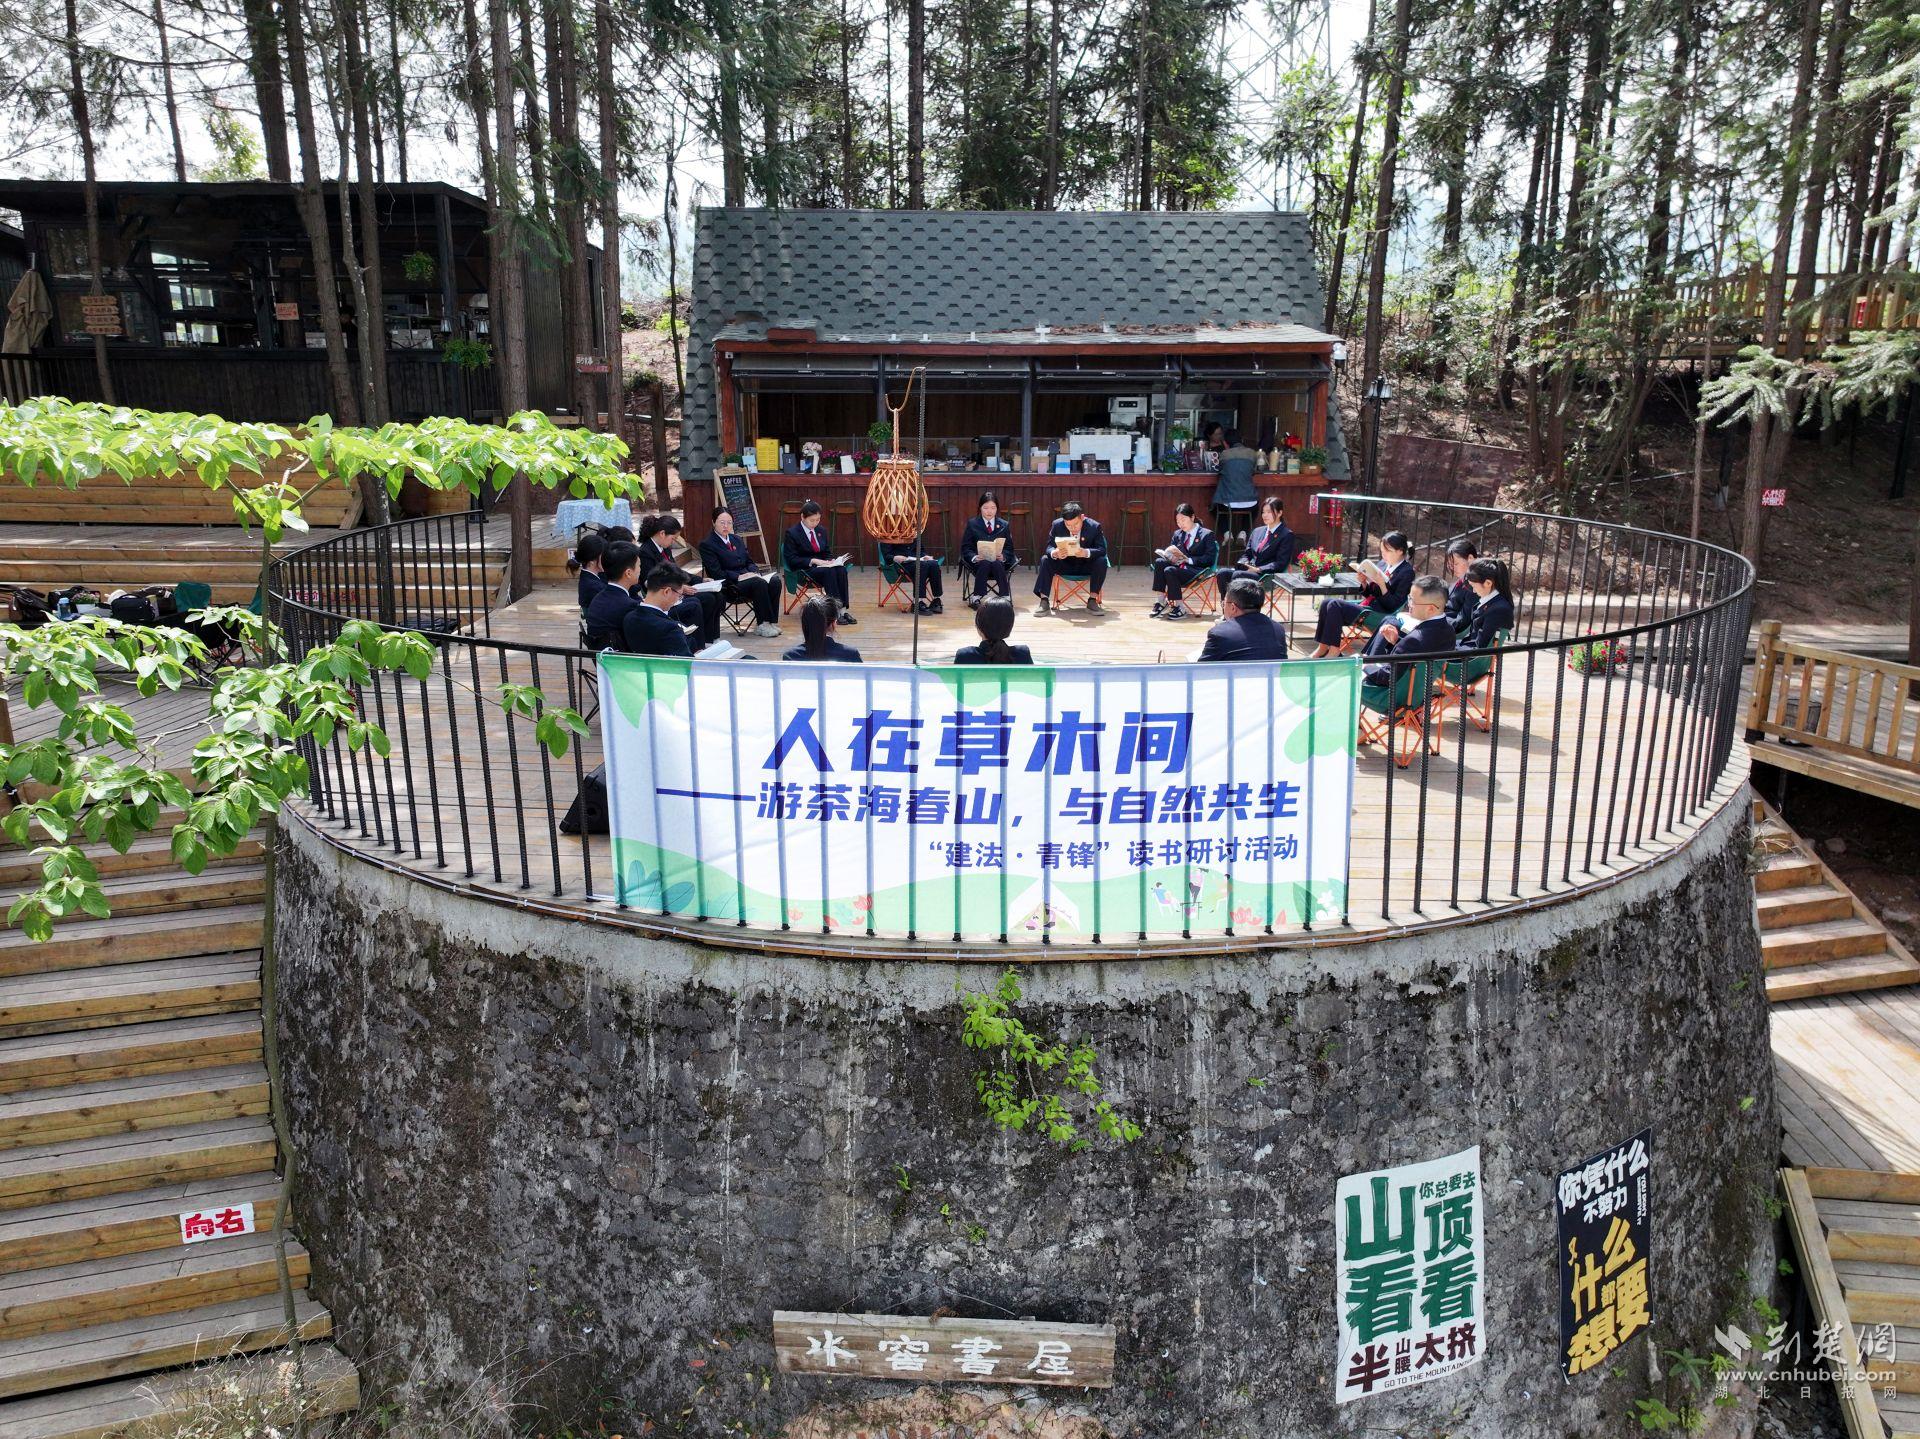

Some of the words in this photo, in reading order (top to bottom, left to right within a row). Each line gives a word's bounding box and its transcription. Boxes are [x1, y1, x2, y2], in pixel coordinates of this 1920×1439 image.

[723, 477, 742, 485] COFFEE
[762, 708, 1194, 775] 人在草木间
[1419, 1171, 1476, 1200] 你总要去
[1558, 1138, 1649, 1215] 你凭什么
[185, 1208, 245, 1239] 向右
[1343, 1176, 1474, 1263] 山顶
[1583, 1186, 1628, 1224] 不努力
[1345, 1251, 1478, 1346] 看看
[1384, 1379, 1396, 1388] GO
[1398, 1376, 1408, 1385] TO
[1410, 1372, 1424, 1382] THE
